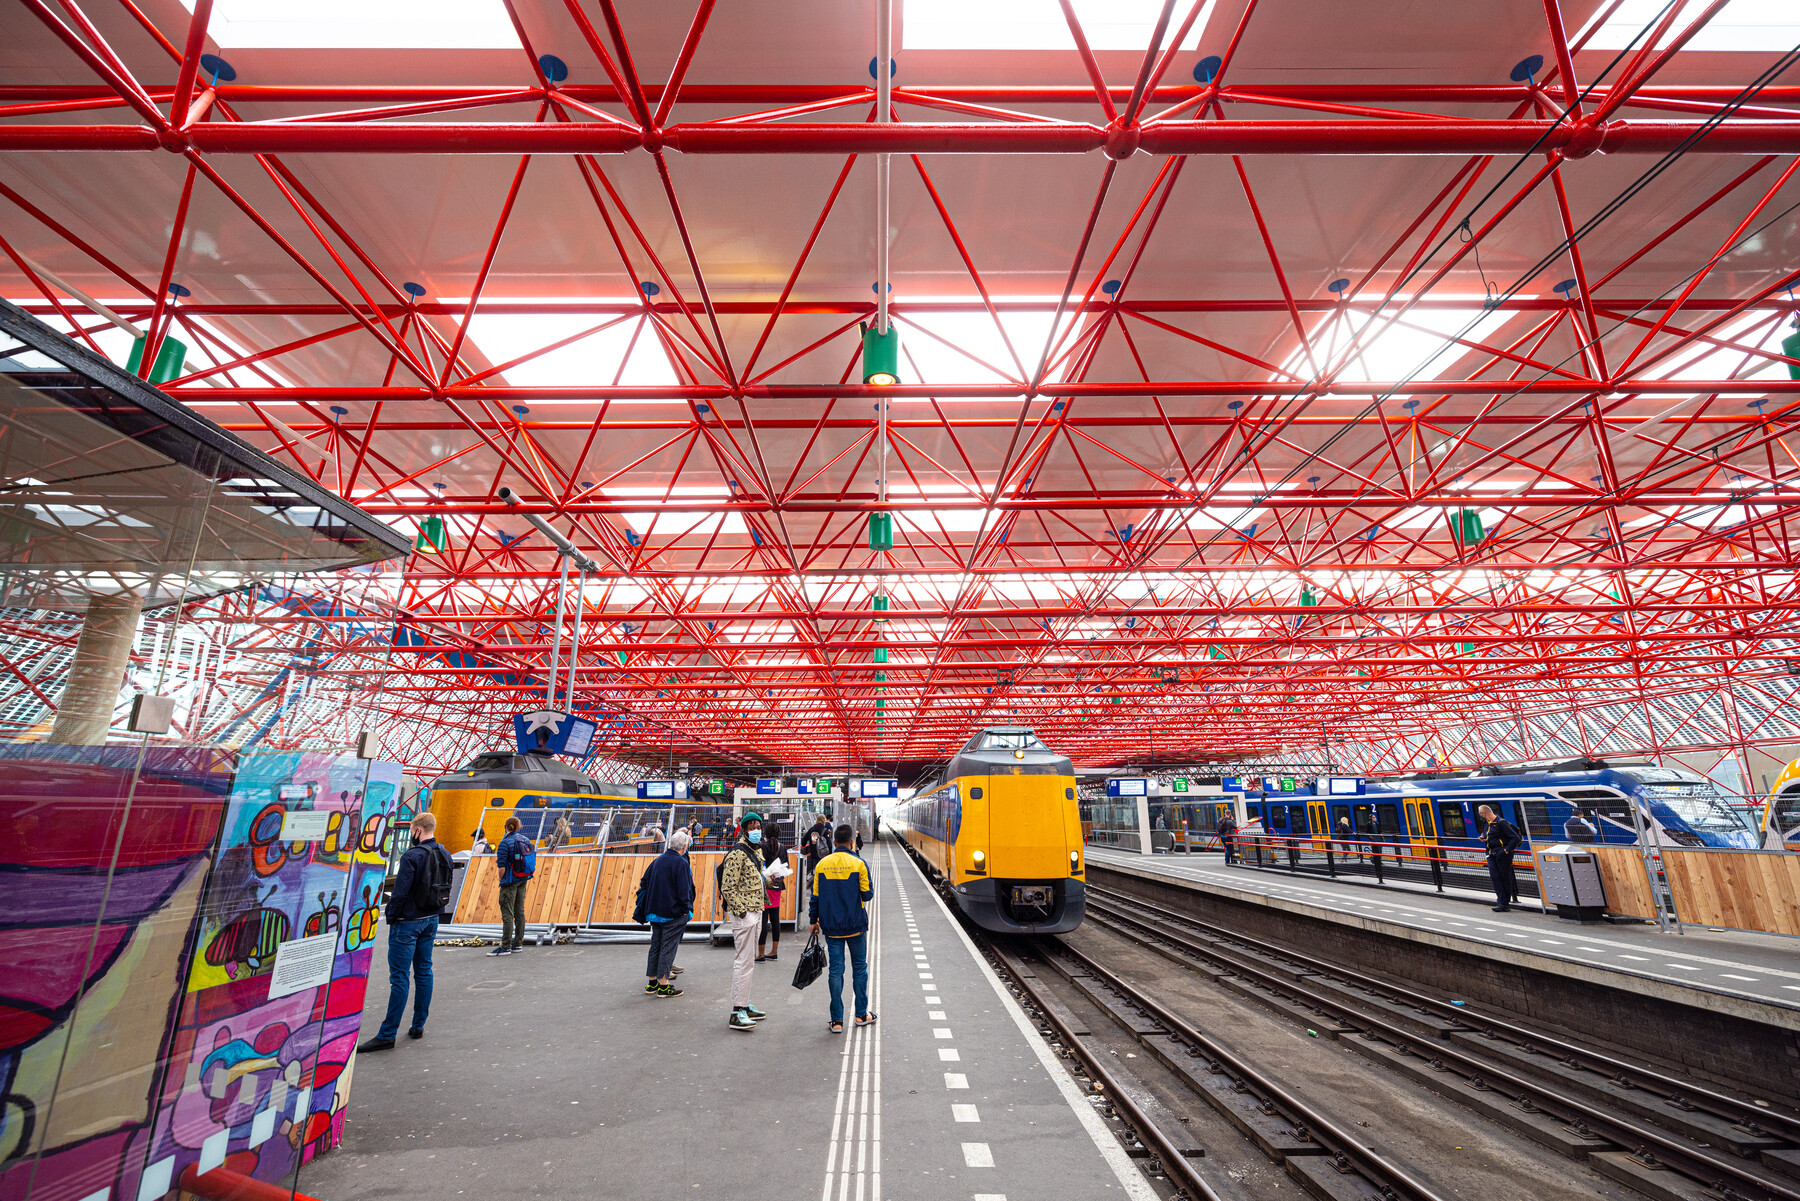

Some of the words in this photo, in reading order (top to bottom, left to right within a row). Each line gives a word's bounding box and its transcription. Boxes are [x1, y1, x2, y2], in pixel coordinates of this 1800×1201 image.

[1284, 805, 1289, 814] 2
[1371, 803, 1377, 813] 2
[1463, 801, 1469, 812] 1
